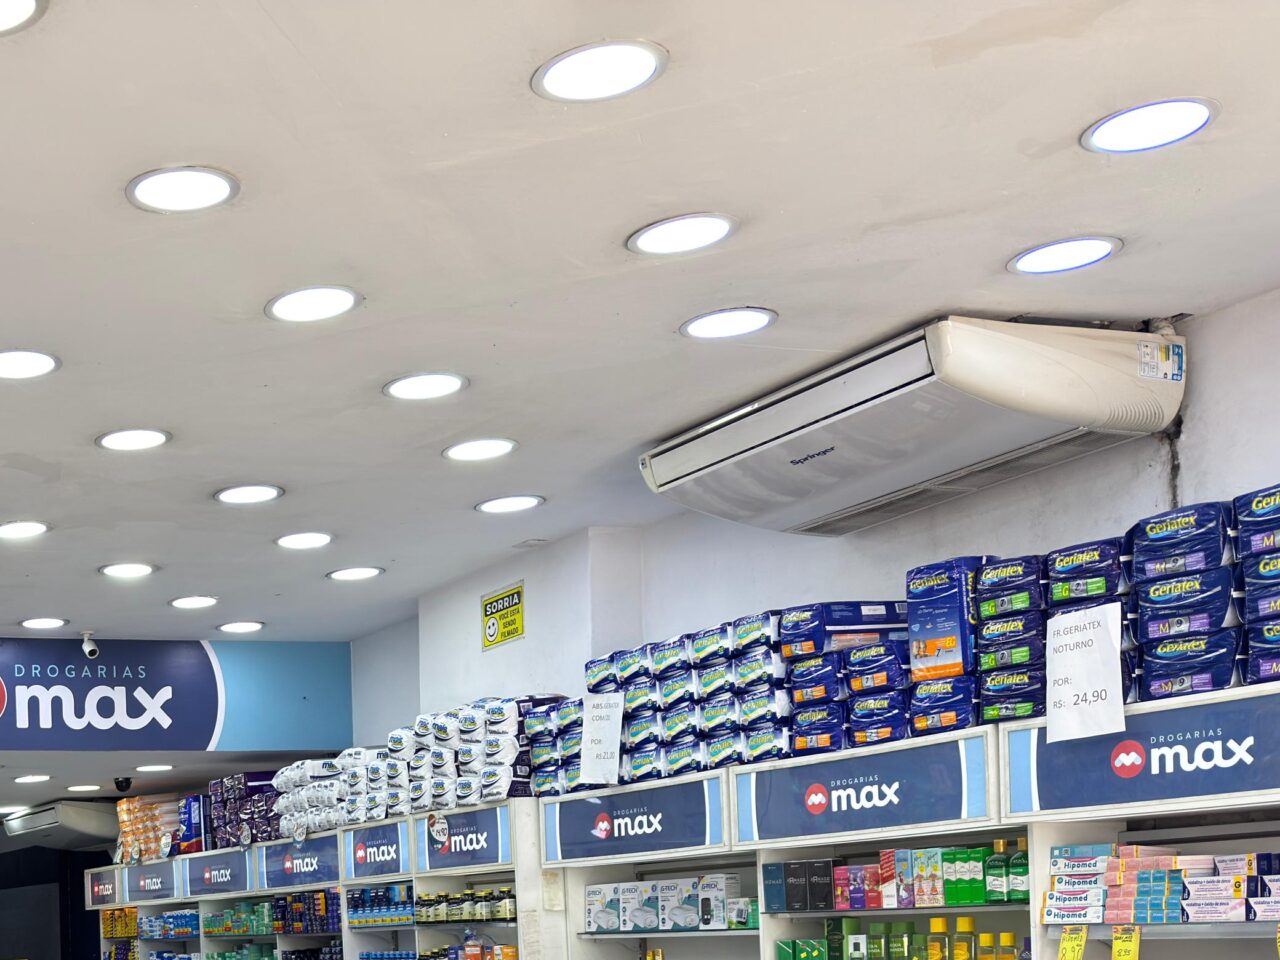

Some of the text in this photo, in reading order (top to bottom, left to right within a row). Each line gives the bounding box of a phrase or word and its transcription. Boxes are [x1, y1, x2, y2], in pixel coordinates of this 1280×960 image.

[790, 445, 836, 467] Springer
[1146, 516, 1196, 535] Geriatex
[1263, 534, 1274, 547] M
[1055, 551, 1100, 567] Geriatex
[983, 563, 1024, 580] Geriatex
[1150, 580, 1200, 597] Geriatex
[486, 594, 519, 615] SORRIA
[503, 619, 516, 629] SENDO
[983, 619, 1024, 634] Geriatex
[1159, 619, 1183, 634] M 9
[501, 627, 518, 639] FILMADO
[1053, 639, 1093, 654] NOTURNO
[15, 664, 147, 678] DROGARIAS
[986, 672, 1029, 686] Geriatex
[1053, 677, 1072, 687] POR:
[1073, 689, 1107, 706] 24,90
[16, 684, 172, 729] max
[1151, 728, 1222, 744] DROGARIAS
[1151, 735, 1254, 775] max
[831, 774, 878, 787] DROGARIAS
[831, 781, 899, 812] max
[613, 806, 647, 816] DROGARIAS
[614, 812, 662, 837] max
[451, 831, 487, 852] max
[367, 844, 396, 863] max
[293, 857, 318, 872] max
[1063, 860, 1097, 870] Hipomed
[212, 867, 230, 882] max
[99, 883, 112, 895] max
[146, 877, 161, 890] max
[1064, 878, 1098, 887] Hipomed
[1055, 894, 1088, 903] Hipomed
